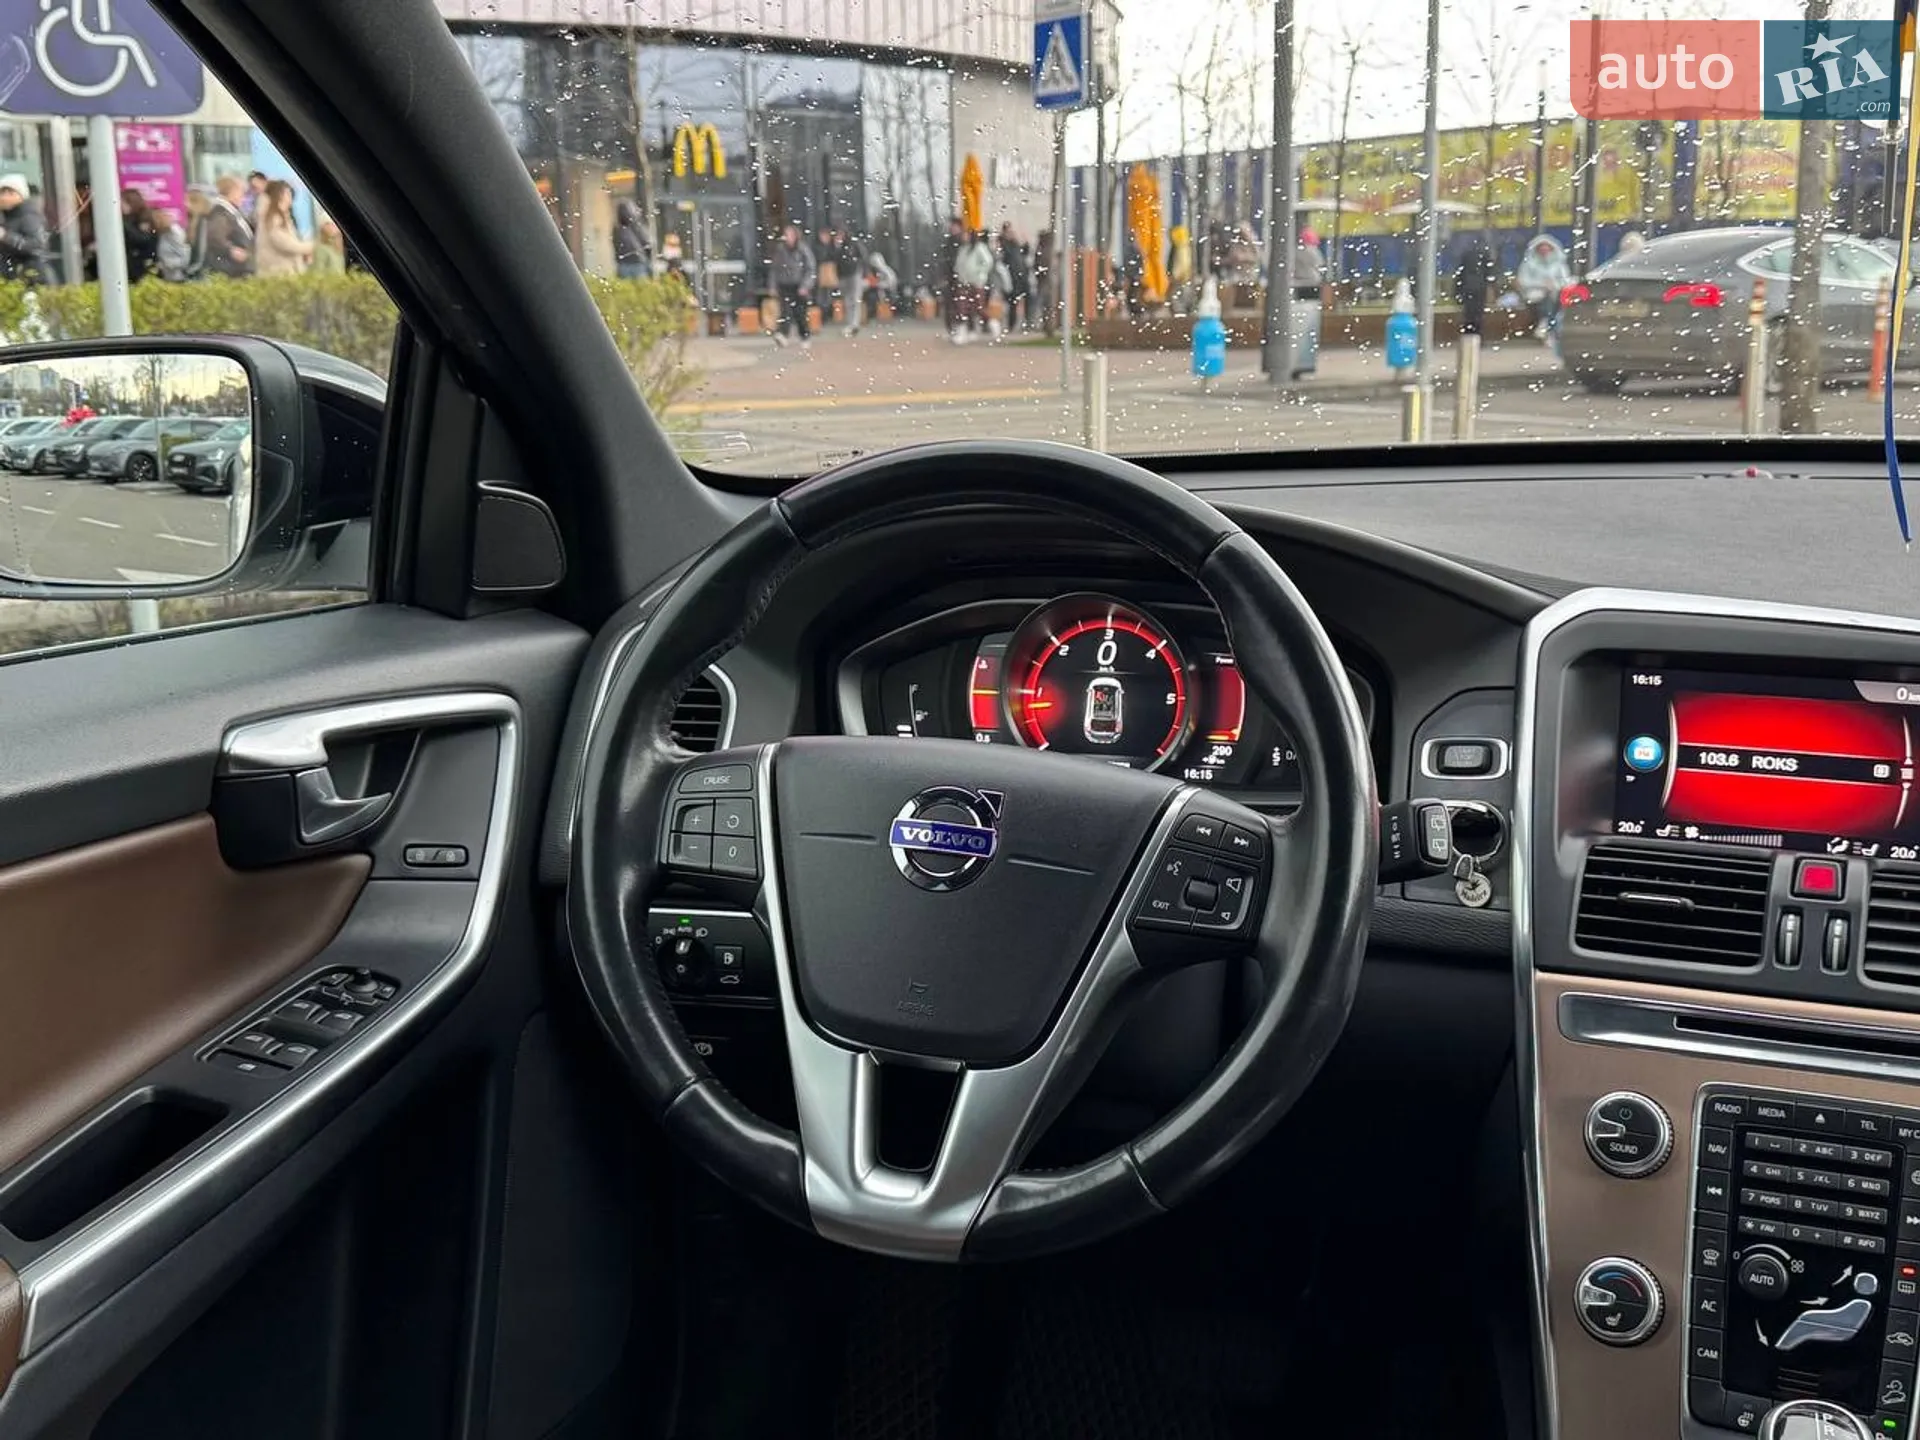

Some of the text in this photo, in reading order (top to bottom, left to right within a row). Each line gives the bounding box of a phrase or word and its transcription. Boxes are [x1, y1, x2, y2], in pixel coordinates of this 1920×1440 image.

[1104, 628, 1114, 640] 3
[1058, 644, 1069, 656] 2
[1097, 640, 1117, 666] 0
[1145, 648, 1156, 659] 4
[1632, 674, 1663, 686] 16:15
[1165, 693, 1176, 705] 5
[1896, 687, 1908, 701] 0
[1212, 746, 1232, 757] 290
[1699, 752, 1799, 772] 103.6 ROKS
[1183, 768, 1213, 780] 16:15
[703, 775, 731, 786] CRUISE
[899, 826, 986, 849] VOLVO
[1152, 900, 1170, 911] EXIT
[1714, 1103, 1742, 1115] RADIO
[1757, 1107, 1786, 1119] MEDIA
[1860, 1120, 1878, 1131] TEL
[1899, 1128, 1912, 1138] MY
[1609, 1142, 1638, 1155] SOUND
[1708, 1144, 1727, 1154] NAV
[1800, 1143, 1834, 1156] 2 ABC
[1851, 1151, 1882, 1161] 3 DEF
[1751, 1165, 1781, 1176] 4 GHI
[1797, 1172, 1831, 1184] 5 JKL
[1848, 1179, 1881, 1190] 6 MNO
[1748, 1193, 1781, 1205] 7 PQRS
[1794, 1200, 1829, 1212] 8 TUV
[1845, 1207, 1881, 1220] 9 WXYZ
[1792, 1228, 1800, 1237] 0
[1749, 1273, 1775, 1286] AUTO
[1701, 1300, 1717, 1312] AC
[1696, 1347, 1719, 1360] CAM
